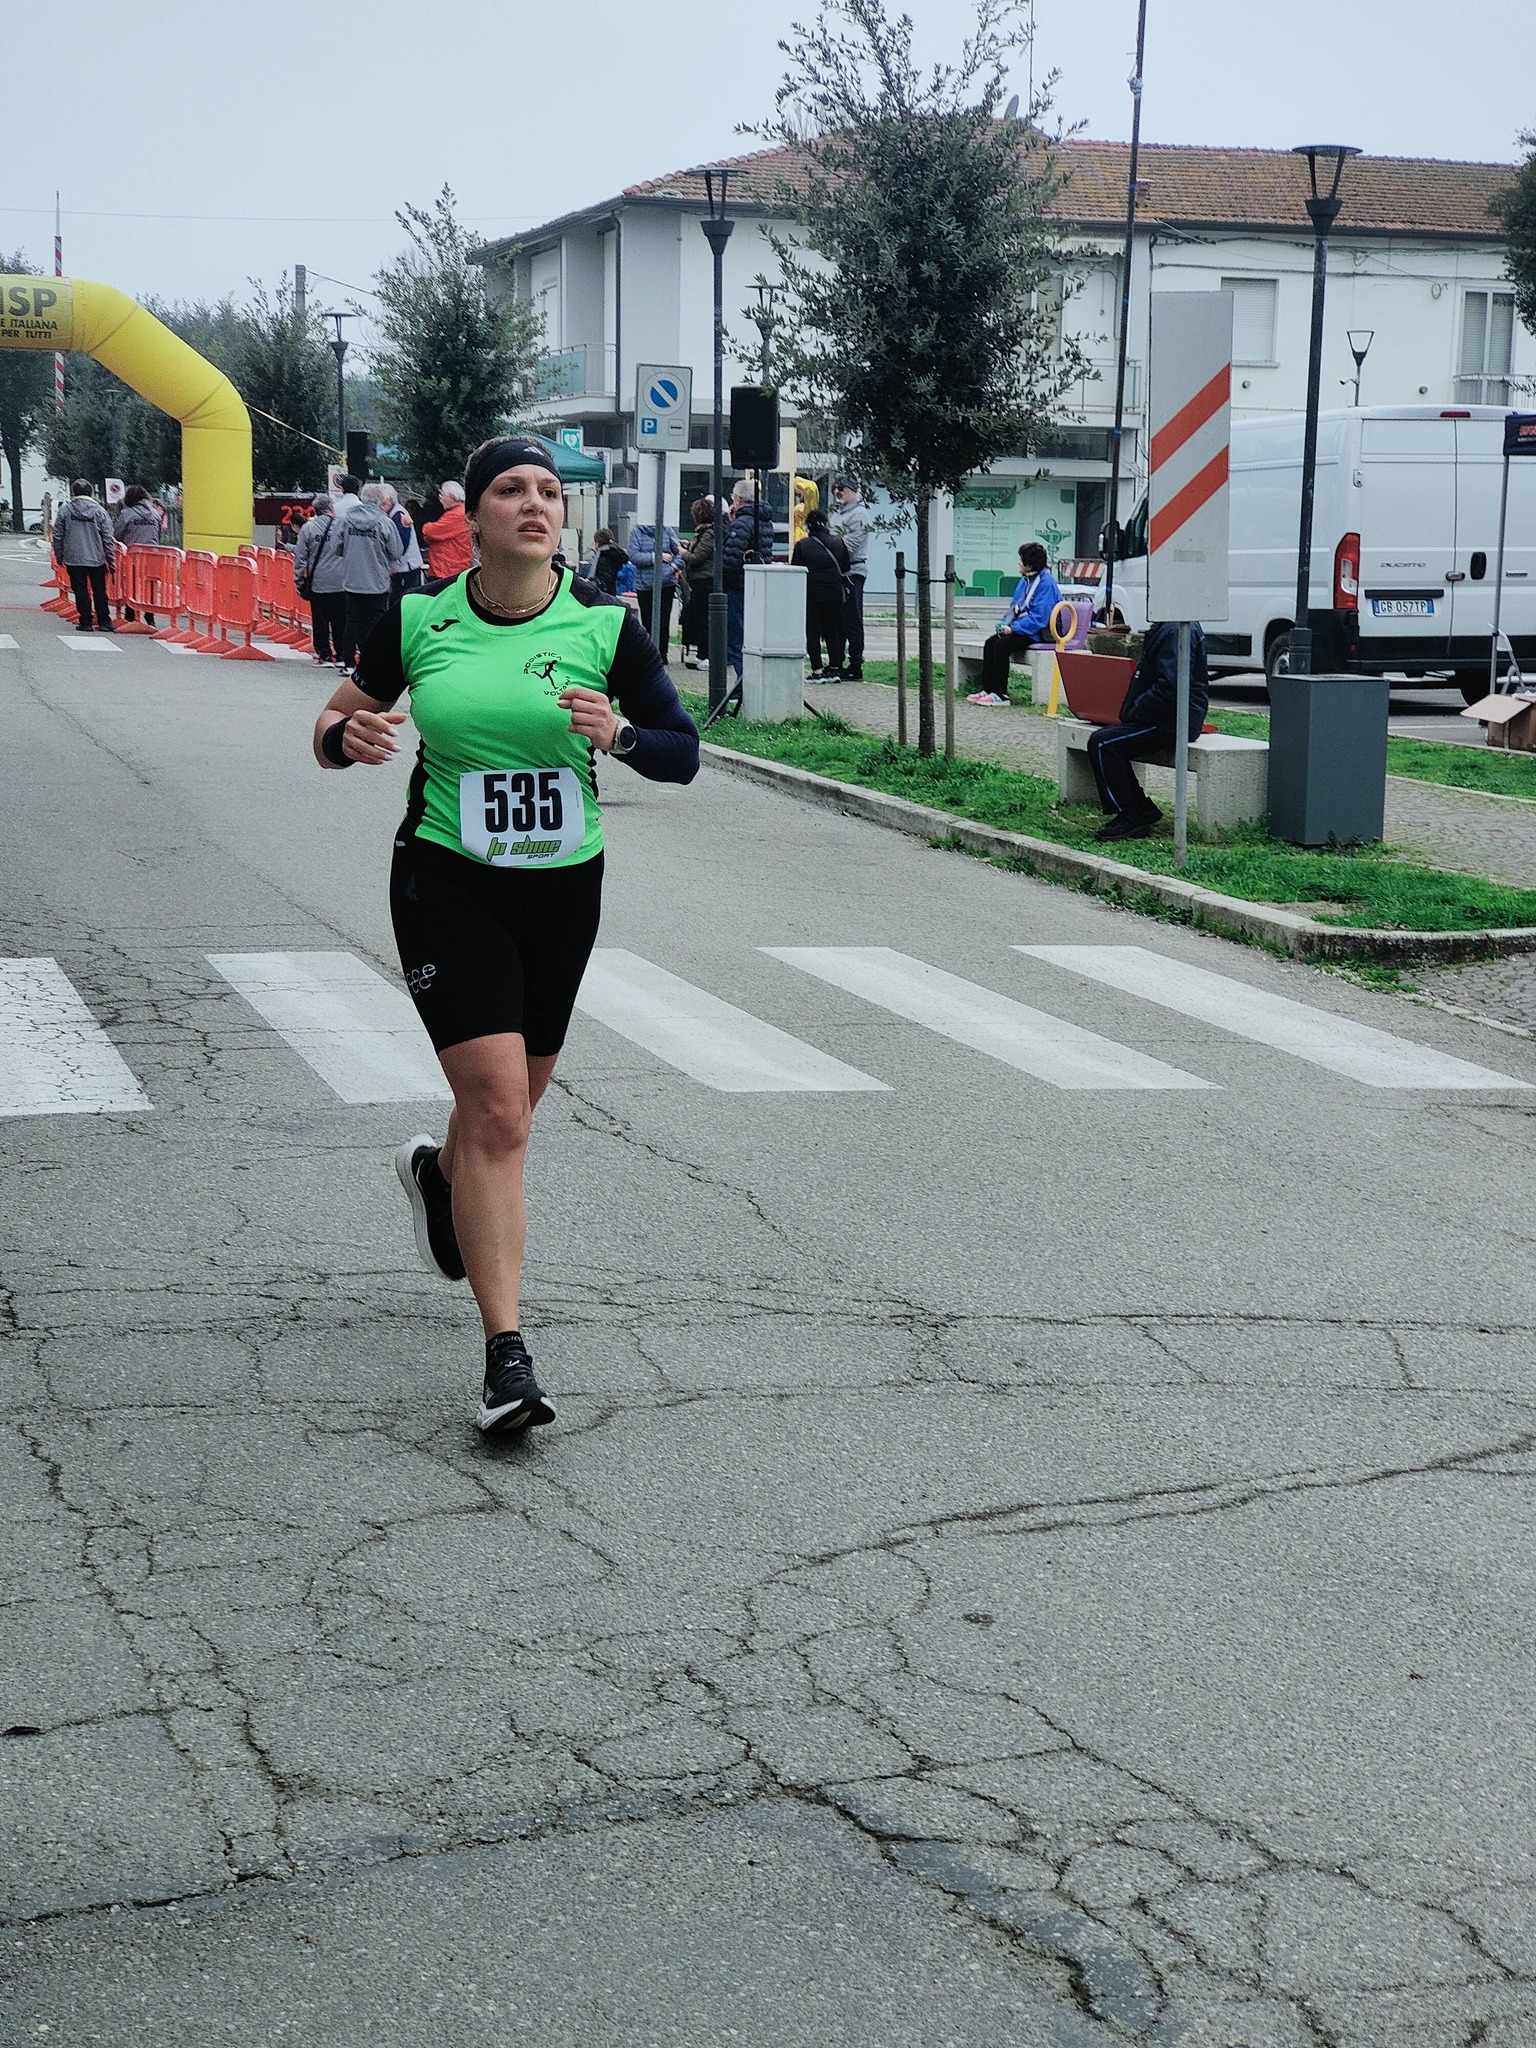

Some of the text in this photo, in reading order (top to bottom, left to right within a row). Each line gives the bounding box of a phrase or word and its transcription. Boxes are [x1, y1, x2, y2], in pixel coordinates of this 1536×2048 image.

[10, 319, 58, 330] ITALIANA
[1, 329, 52, 339] PER TUTTI
[643, 419, 655, 433] P
[483, 771, 563, 833] 535
[509, 834, 562, 855] shine
